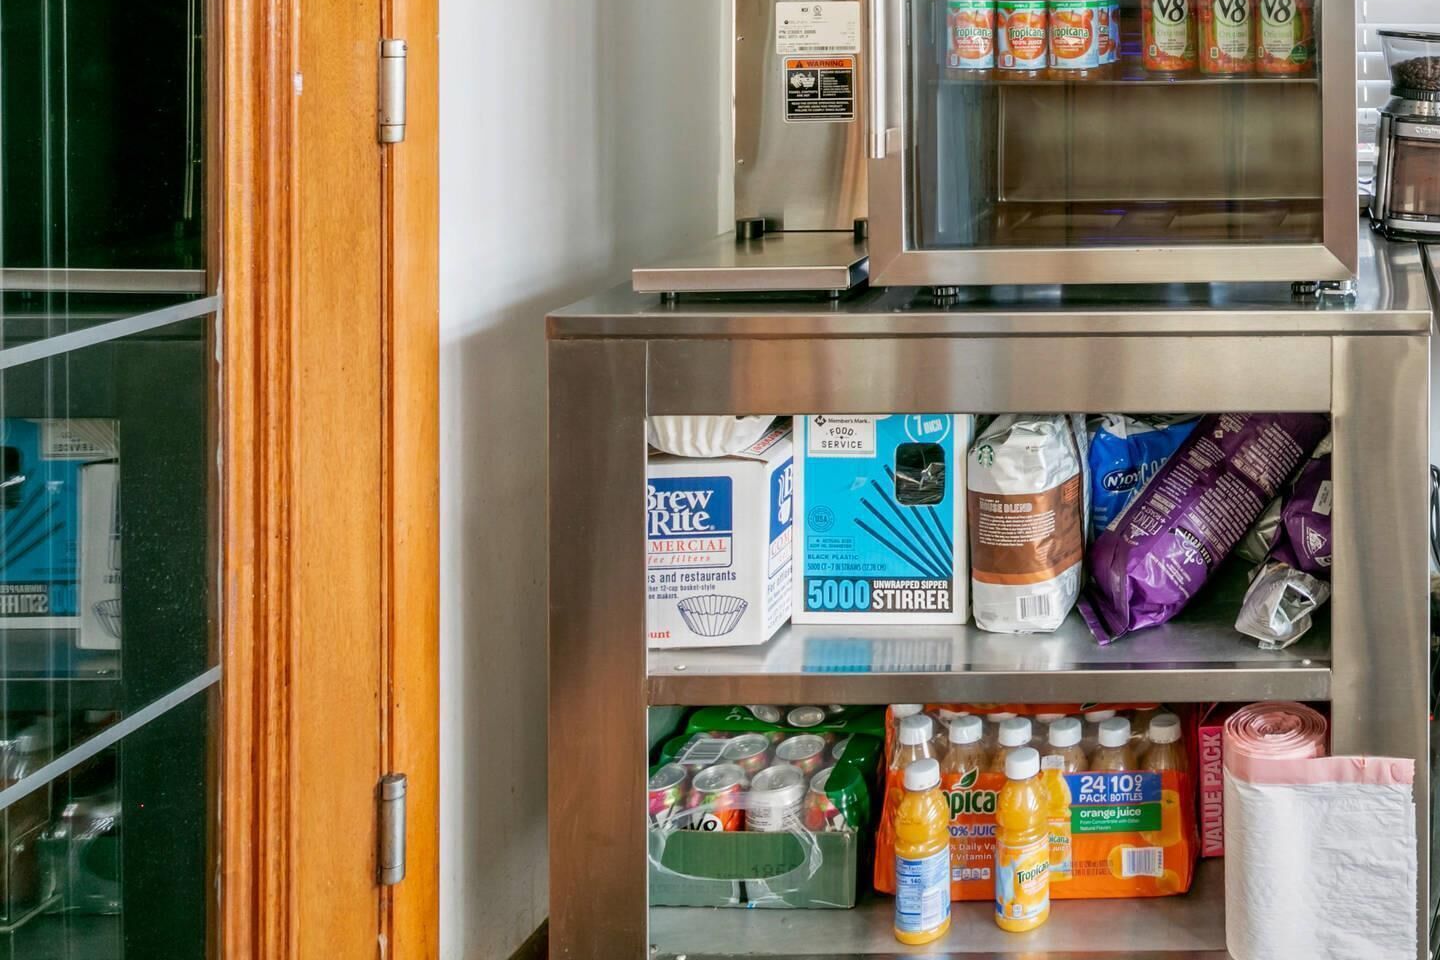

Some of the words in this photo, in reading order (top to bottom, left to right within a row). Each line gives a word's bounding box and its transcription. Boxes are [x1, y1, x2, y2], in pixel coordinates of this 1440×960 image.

[1009, 27, 1045, 38] Tropicana
[830, 428, 854, 436] FOOD
[822, 440, 863, 449] SERVICE
[648, 484, 714, 510] Brew
[1004, 502, 1032, 513] BLEND
[649, 509, 710, 536] Rite
[650, 539, 727, 553] MERCIAL
[671, 554, 710, 564] filters
[660, 572, 677, 583] and
[680, 570, 736, 582] restaurants
[680, 584, 716, 592] basket-style
[874, 580, 919, 589] UNWRAPPED
[920, 580, 948, 589] SIPPER
[808, 580, 870, 609] 5000
[872, 590, 949, 610] STIRRER
[649, 630, 670, 638] unt
[1202, 732, 1222, 786] PACK
[1080, 775, 1106, 793] 24
[1110, 774, 1134, 792] 10
[1080, 793, 1106, 802] PACK
[1110, 793, 1143, 802] BOTTLES
[1080, 809, 1116, 820] orange
[1117, 807, 1141, 818] juice
[1202, 796, 1222, 852] VALUE
[972, 825, 996, 836] JUIC
[959, 840, 982, 852] Daily
[957, 852, 992, 861] Vitamin
